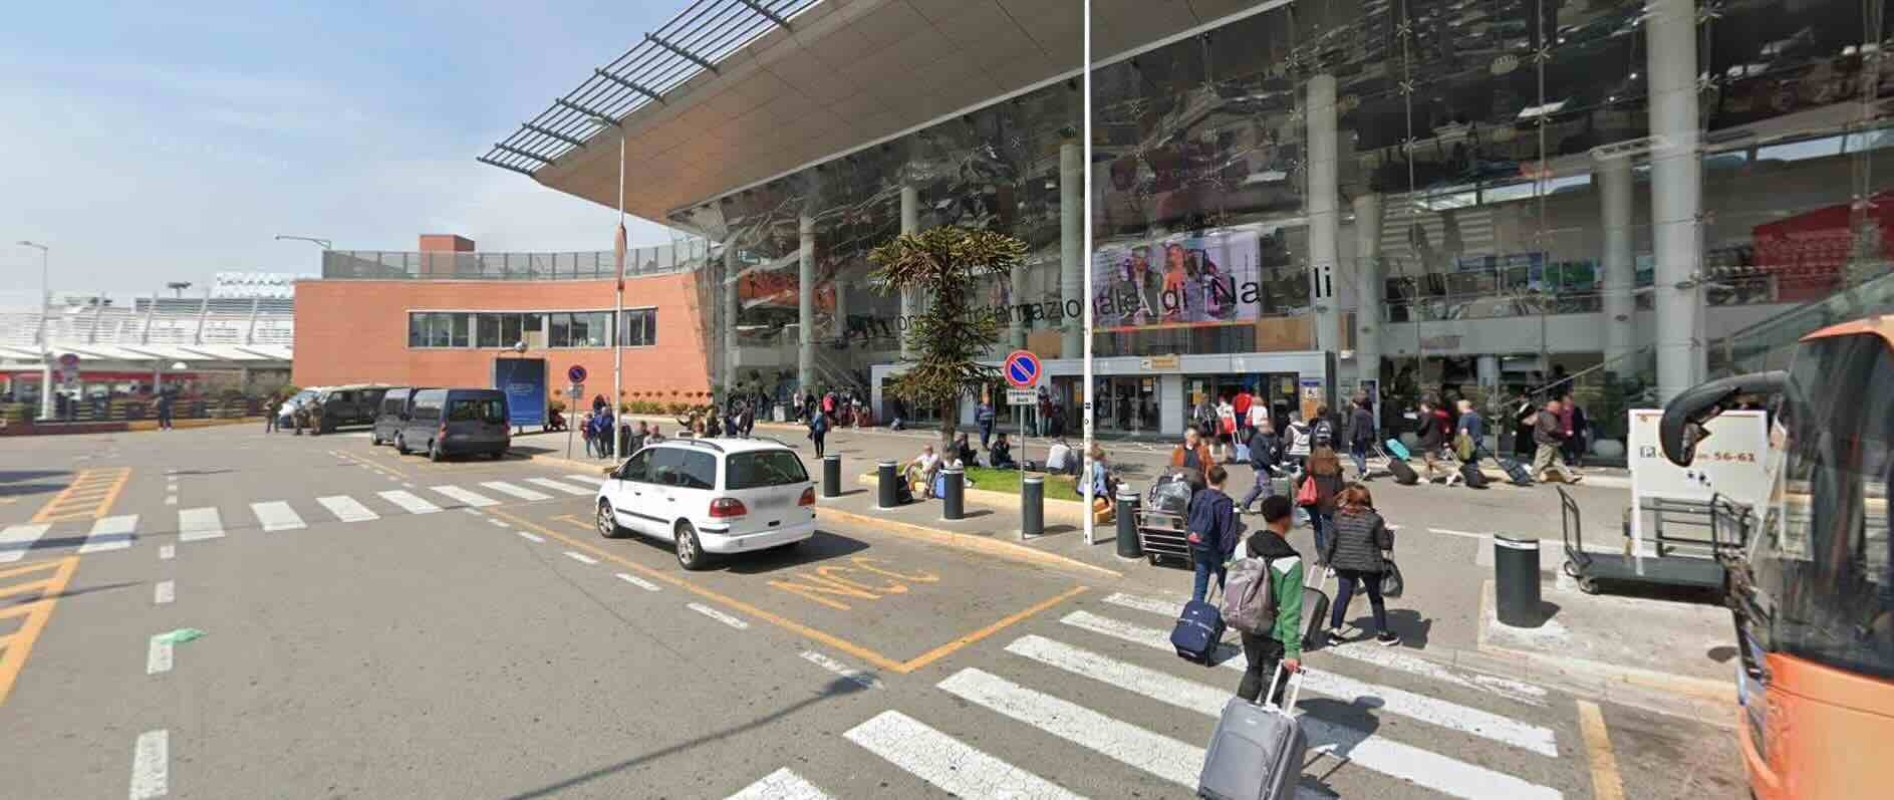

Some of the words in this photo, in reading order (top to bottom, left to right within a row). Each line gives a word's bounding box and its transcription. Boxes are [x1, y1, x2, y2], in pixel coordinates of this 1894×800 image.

[1163, 281, 1189, 312] di
[1211, 266, 1332, 306] Nali
[766, 554, 940, 610] NCC
